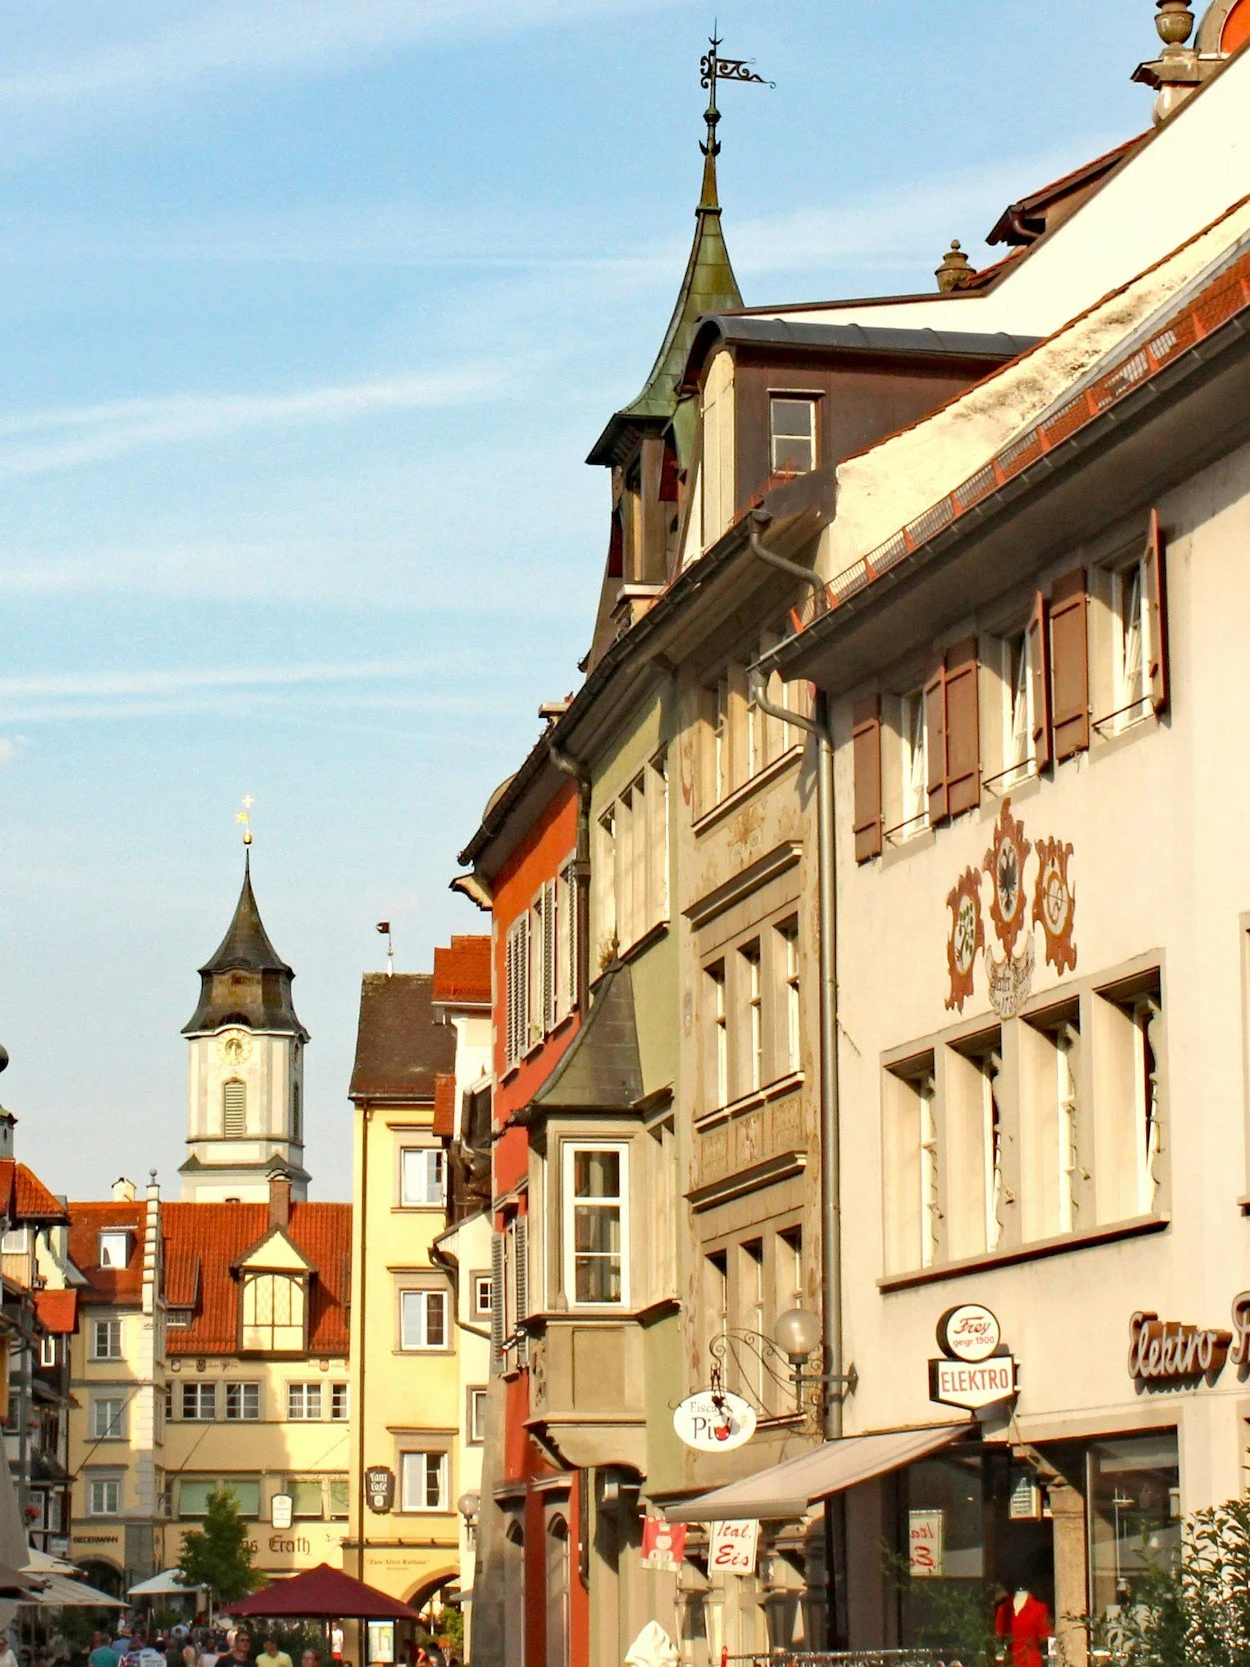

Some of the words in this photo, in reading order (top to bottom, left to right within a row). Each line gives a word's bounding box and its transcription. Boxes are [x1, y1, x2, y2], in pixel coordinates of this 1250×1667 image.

[953, 1316, 991, 1335] Frey
[976, 1335, 995, 1345] 1900
[1128, 1310, 1223, 1379] Elektro
[941, 1368, 1009, 1392] ELEKTRO
[690, 1401, 717, 1414] Eisca
[268, 1535, 311, 1556] Erath
[715, 1544, 749, 1567] Eis
